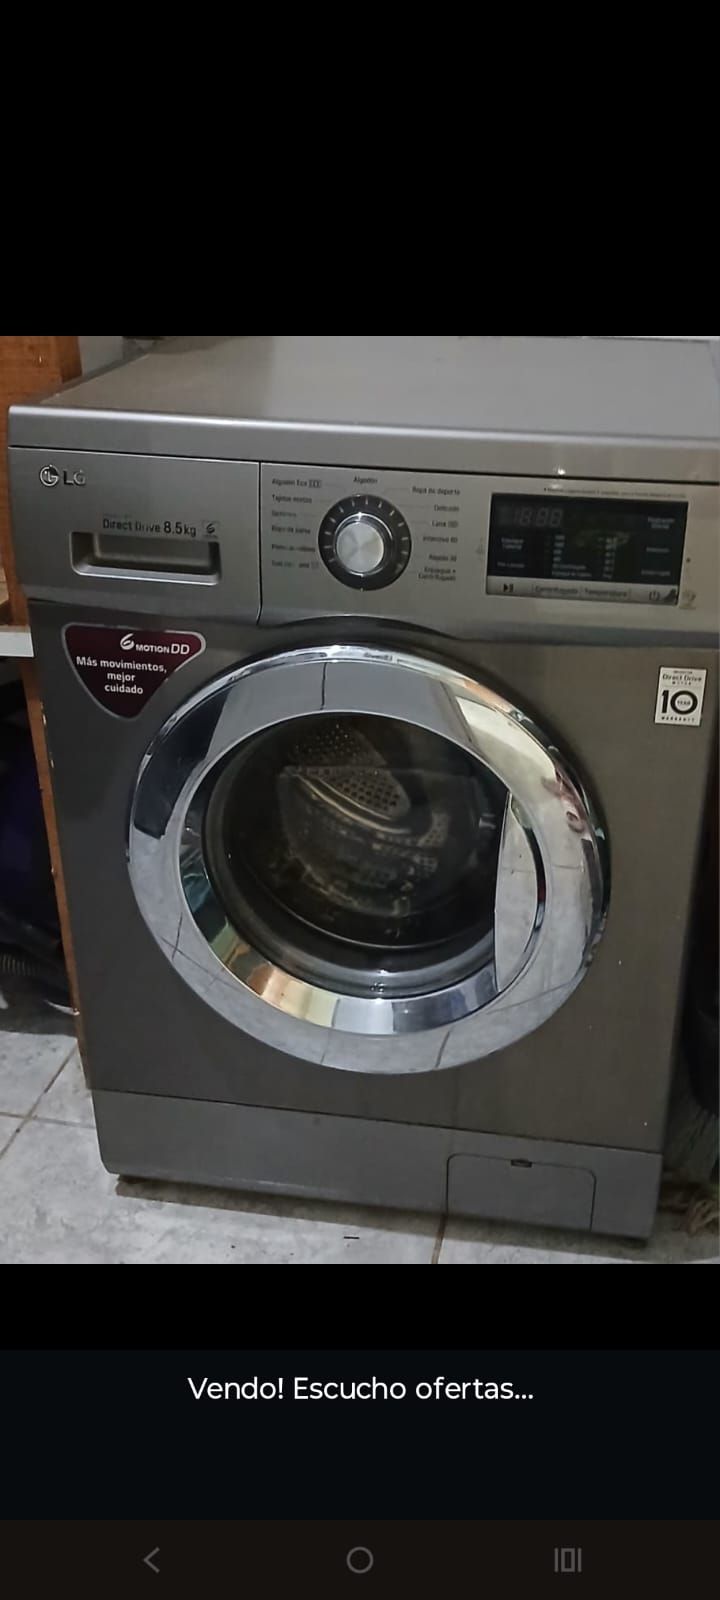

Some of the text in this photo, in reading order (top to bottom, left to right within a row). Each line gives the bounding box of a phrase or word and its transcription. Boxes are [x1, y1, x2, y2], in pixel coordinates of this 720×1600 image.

[62, 469, 87, 487] LG
[102, 518, 133, 531] Direct
[135, 520, 160, 533] Drive
[135, 643, 170, 654] MOTION
[76, 656, 167, 673] Más movimientos,
[107, 671, 136, 683] mejor
[104, 683, 144, 695] cuidado
[661, 690, 698, 715] 10
